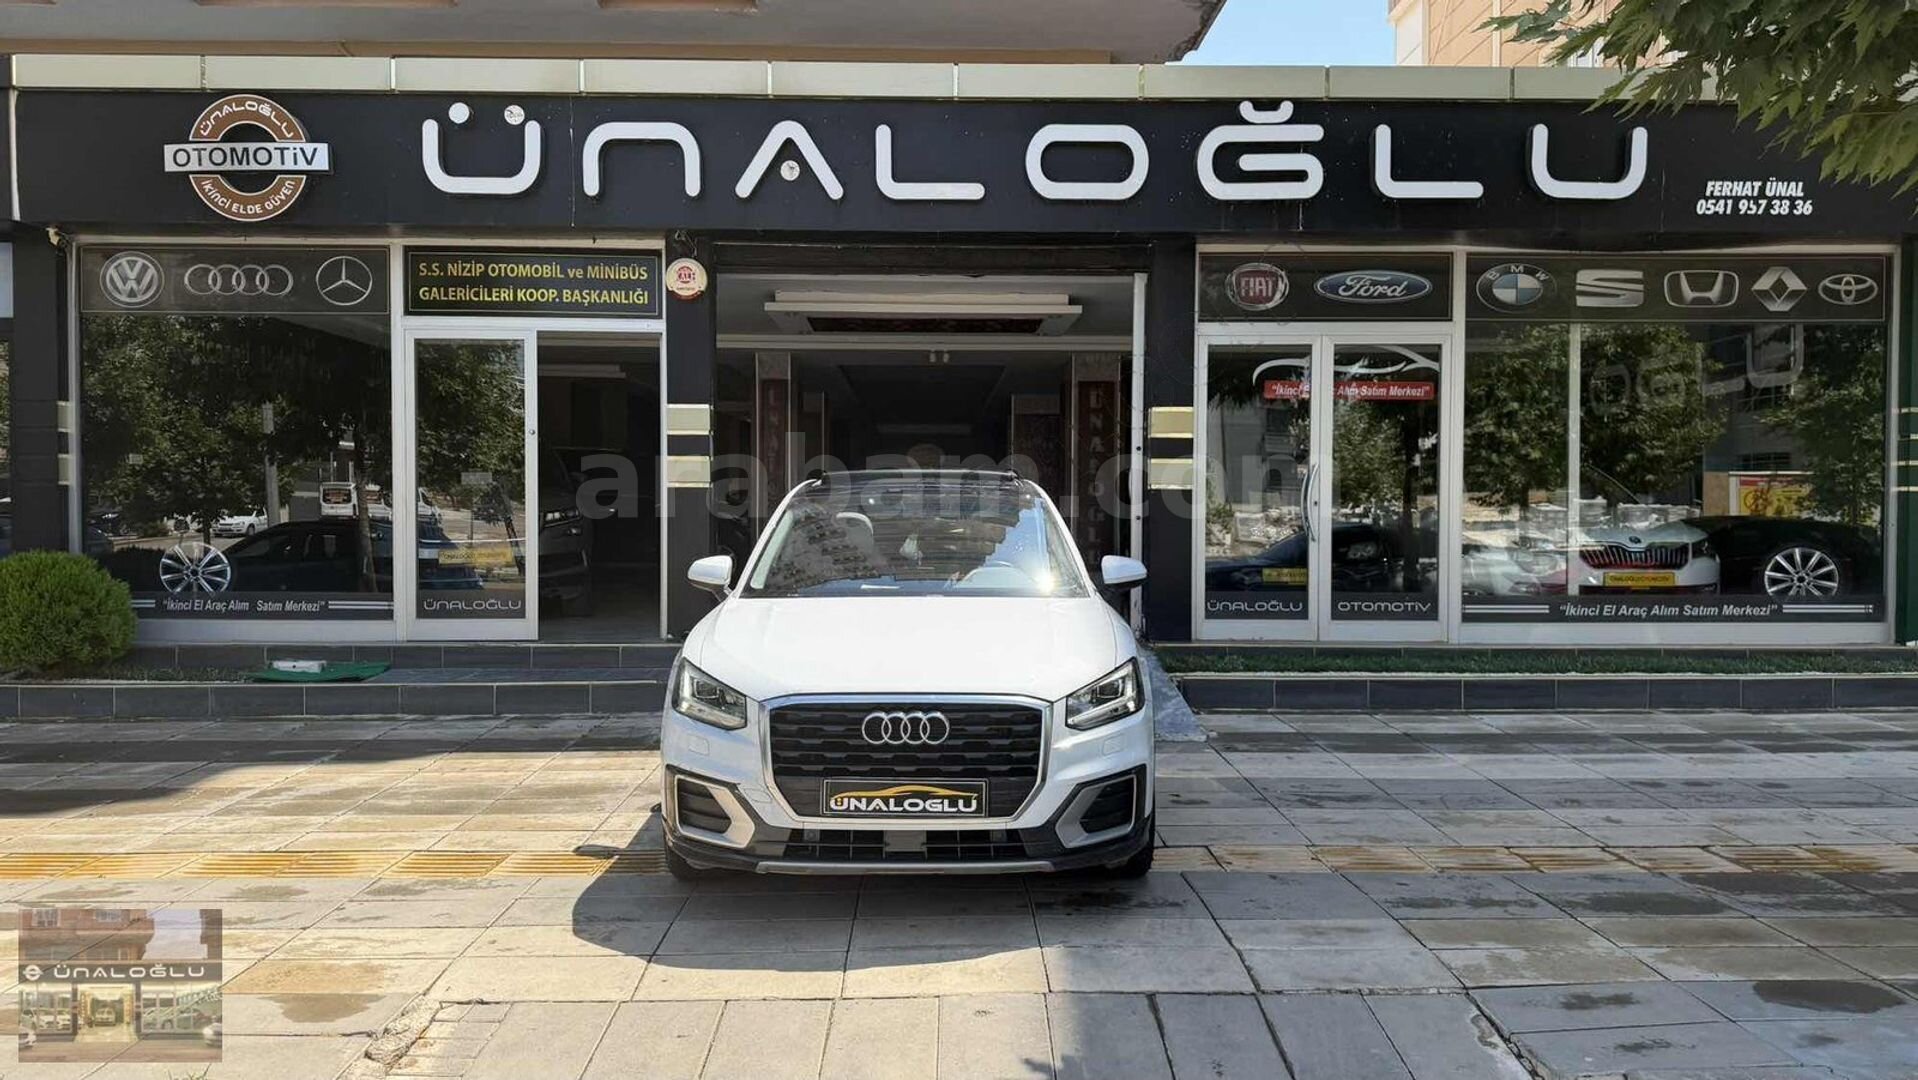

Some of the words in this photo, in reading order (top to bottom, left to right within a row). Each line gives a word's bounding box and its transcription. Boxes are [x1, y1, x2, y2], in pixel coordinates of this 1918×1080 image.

[421, 99, 1649, 201] ÜNALOĞLU
[1705, 181, 1763, 197] FERHAT
[1765, 177, 1804, 197] ÜNAL
[231, 203, 263, 214] ELDE
[1696, 199, 1733, 215] 0541
[1770, 199, 1790, 215] 38
[1793, 199, 1813, 215] 36
[419, 263, 444, 276] S.S.
[447, 260, 484, 276] NİZİP
[488, 260, 564, 279] OTOMOBİL
[567, 268, 584, 279] ve
[586, 263, 648, 280] MİNİBÜS
[1240, 276, 1276, 297] FIAT
[1338, 273, 1406, 297] Ford
[419, 286, 514, 302] GALERİCİLERİ
[516, 287, 559, 302] KOOP.
[562, 288, 649, 306] BAŞKANLIĞI
[205, 600, 227, 613] Araç
[229, 600, 249, 611] Alım
[257, 600, 282, 612] Satım
[424, 599, 522, 610] ÜNALOĞLU
[1207, 600, 1303, 612] ÜNALOĞLU
[1602, 605, 1616, 616] El
[1618, 605, 1648, 618] Araç
[1650, 604, 1679, 616] Alım
[1682, 604, 1719, 616] Satım
